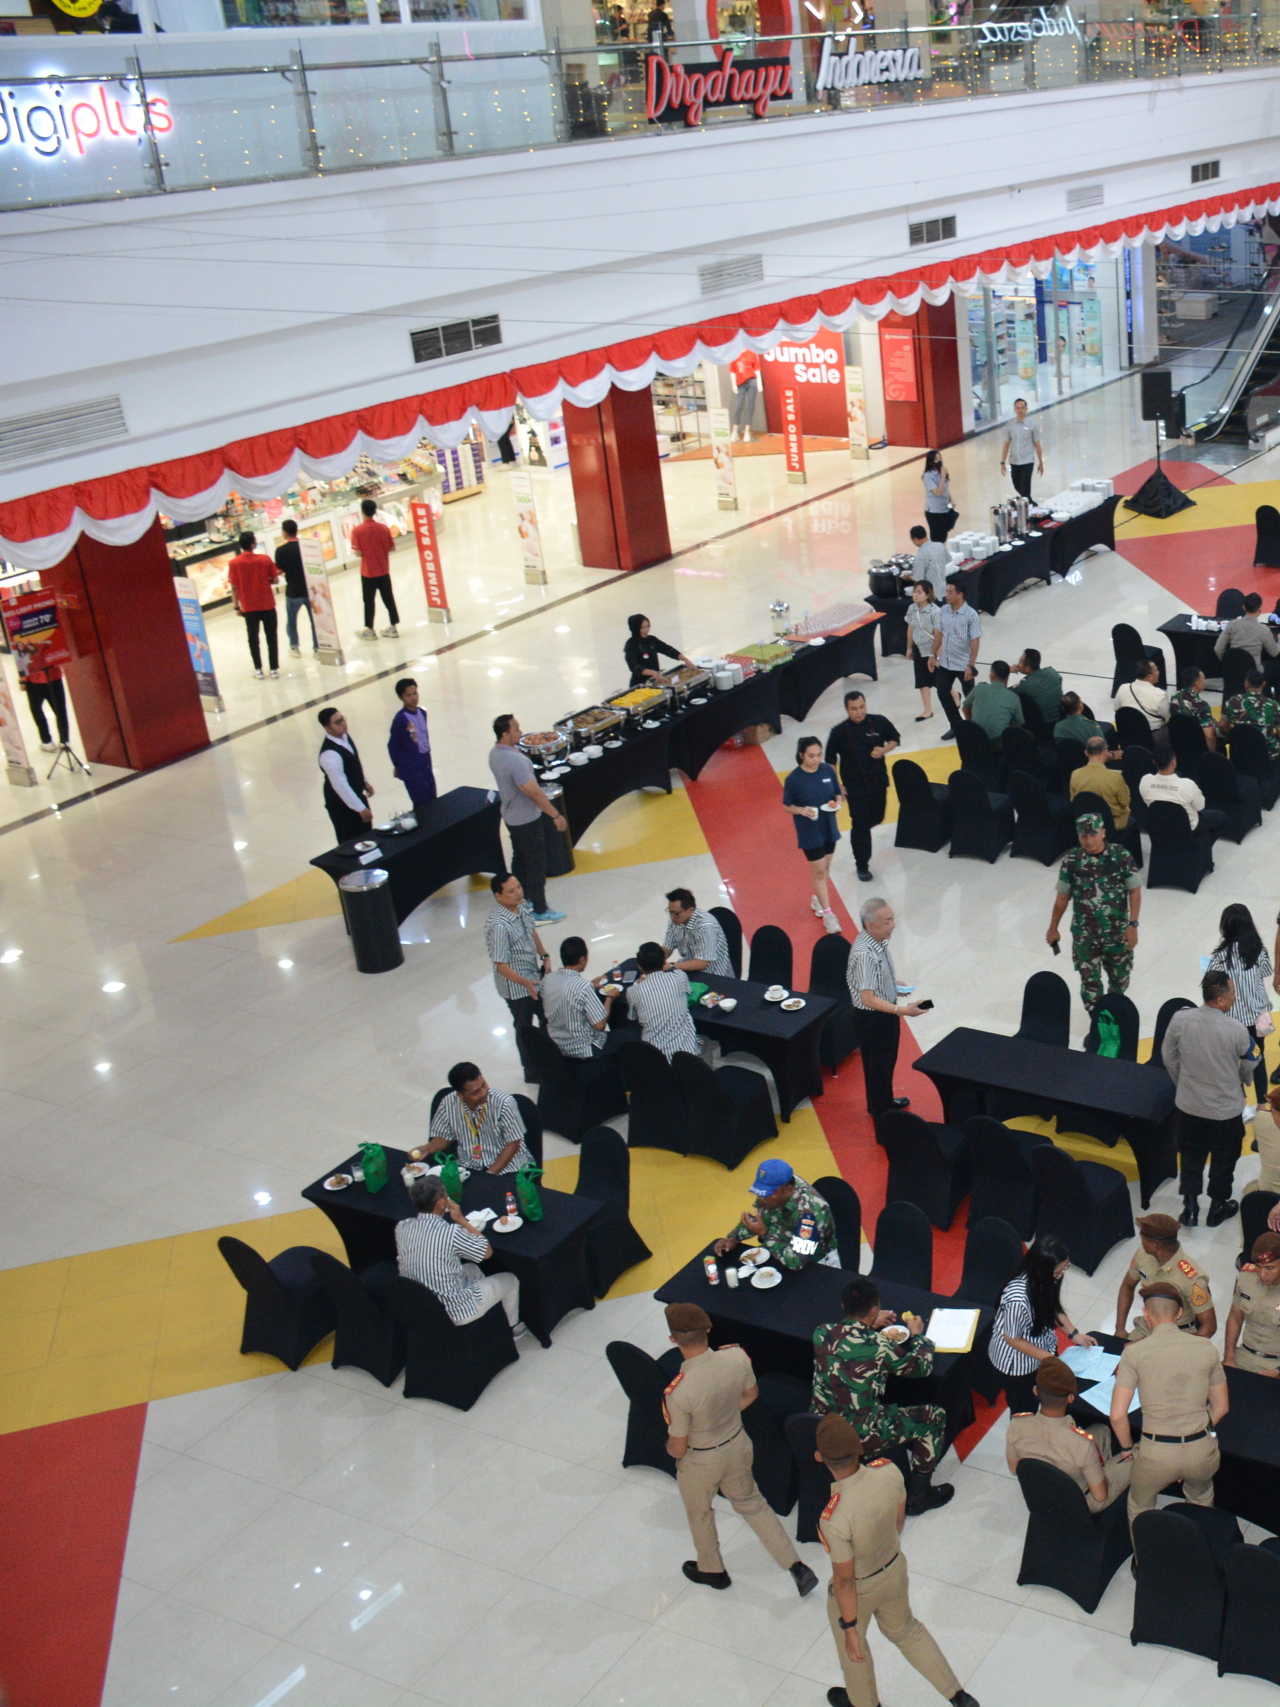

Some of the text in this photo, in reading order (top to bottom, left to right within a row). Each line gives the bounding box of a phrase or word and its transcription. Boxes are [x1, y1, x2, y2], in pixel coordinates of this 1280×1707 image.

[647, 37, 925, 126] Dirgahayu Indonesia
[763, 343, 838, 365] Jumbo
[794, 363, 841, 384] Sale
[784, 389, 800, 470] JUMBO SALE
[416, 507, 441, 606] JUMBO SALE
